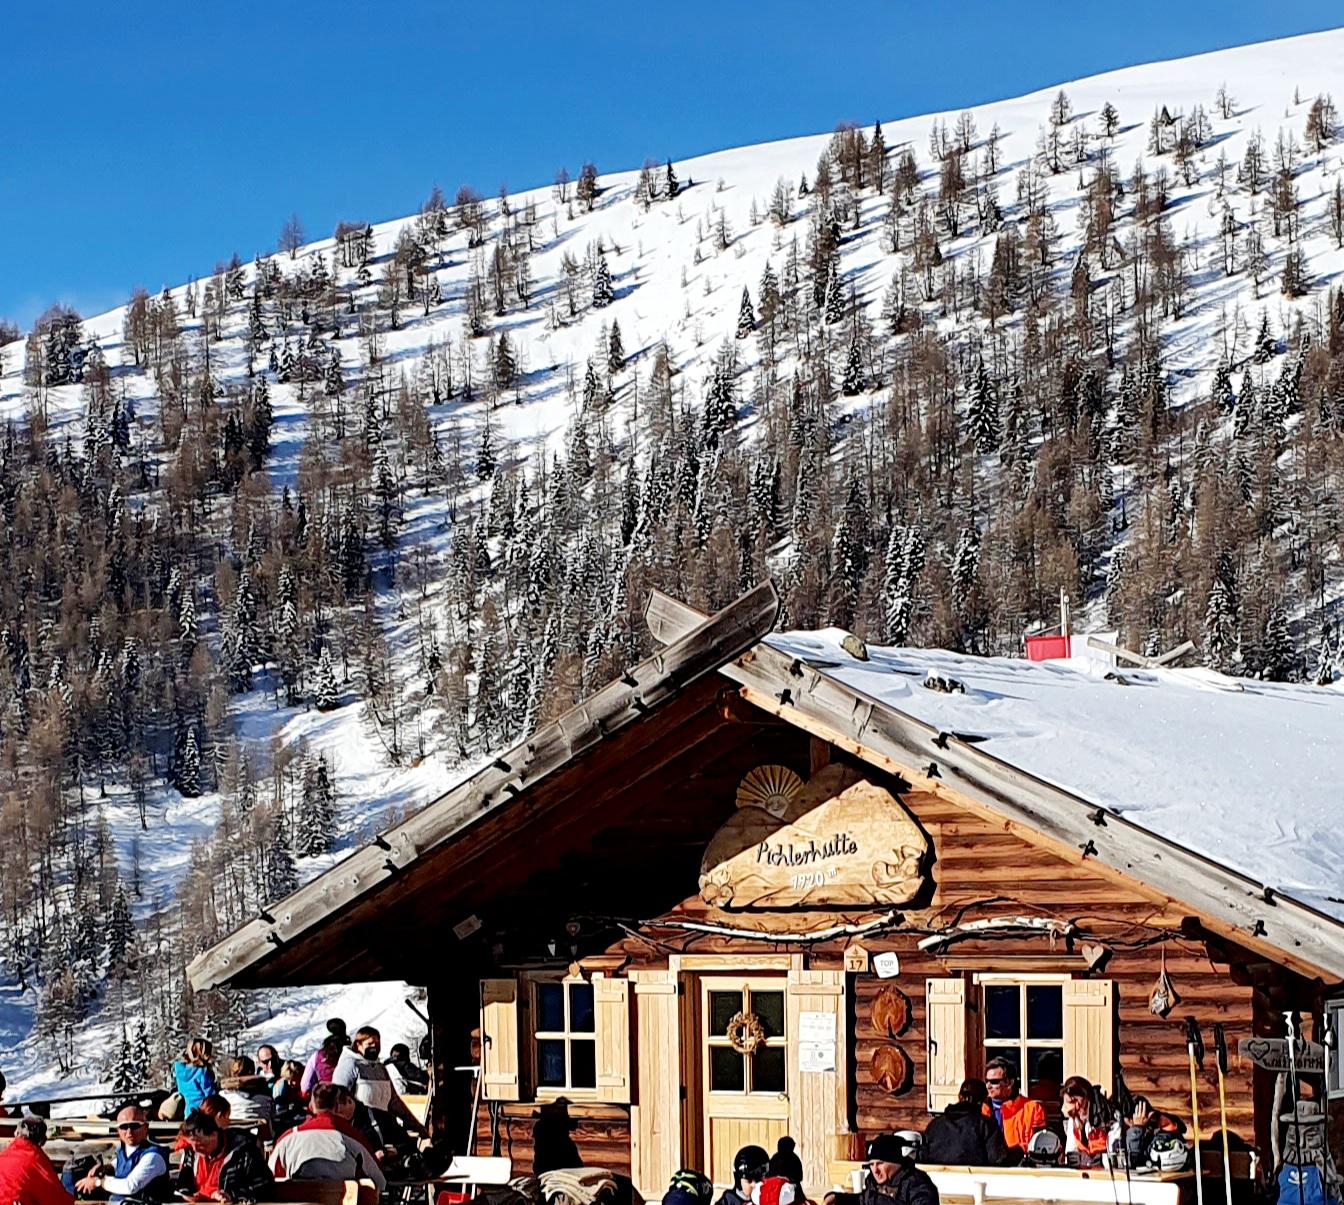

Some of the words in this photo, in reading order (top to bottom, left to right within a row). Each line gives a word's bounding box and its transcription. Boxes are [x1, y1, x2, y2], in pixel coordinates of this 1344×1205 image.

[792, 870, 825, 889] 1920
[849, 960, 863, 970] 17
[880, 959, 894, 967] TOP
